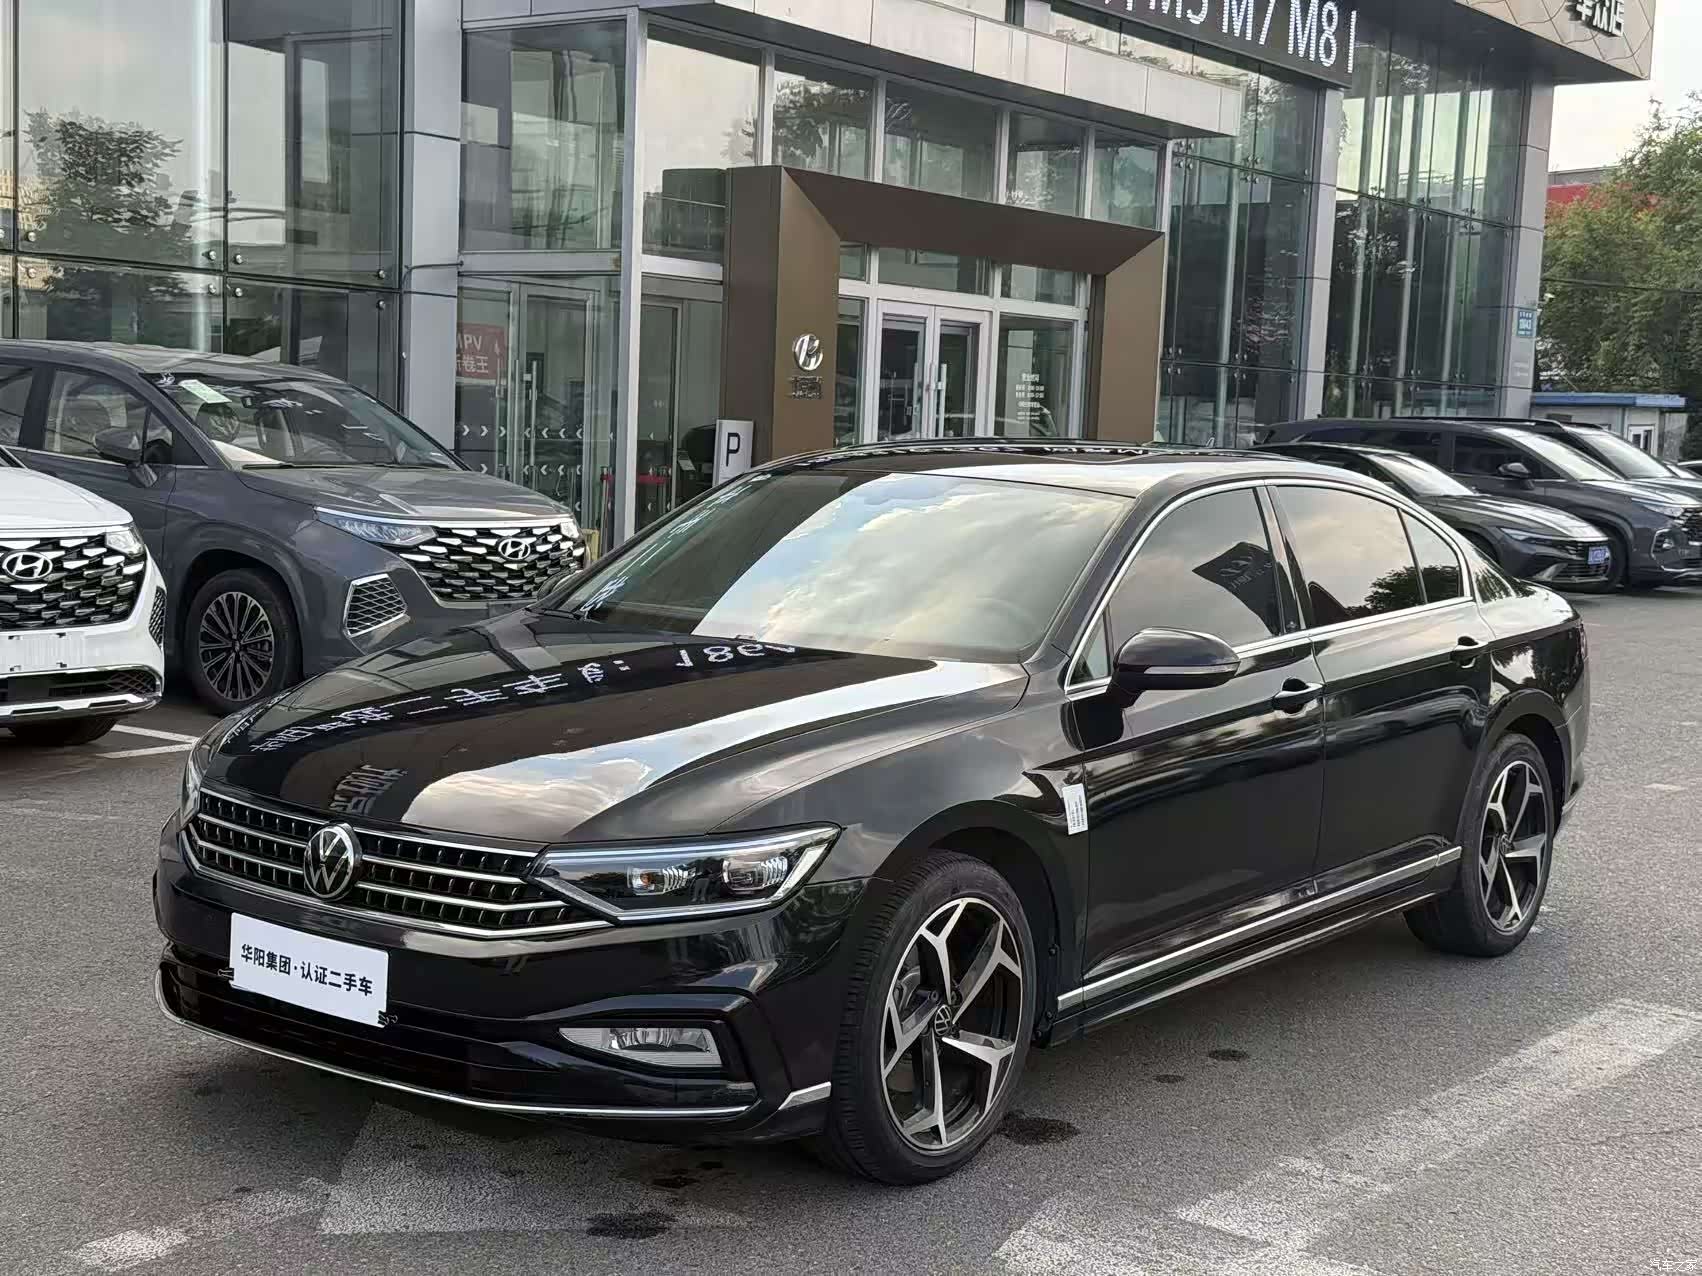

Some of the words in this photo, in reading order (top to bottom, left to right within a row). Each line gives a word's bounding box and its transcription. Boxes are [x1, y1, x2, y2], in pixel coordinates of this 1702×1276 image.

[1288, 0, 1339, 67] M8
[726, 432, 741, 467] P
[240, 943, 373, 997] 华阳集团·认证二手车
